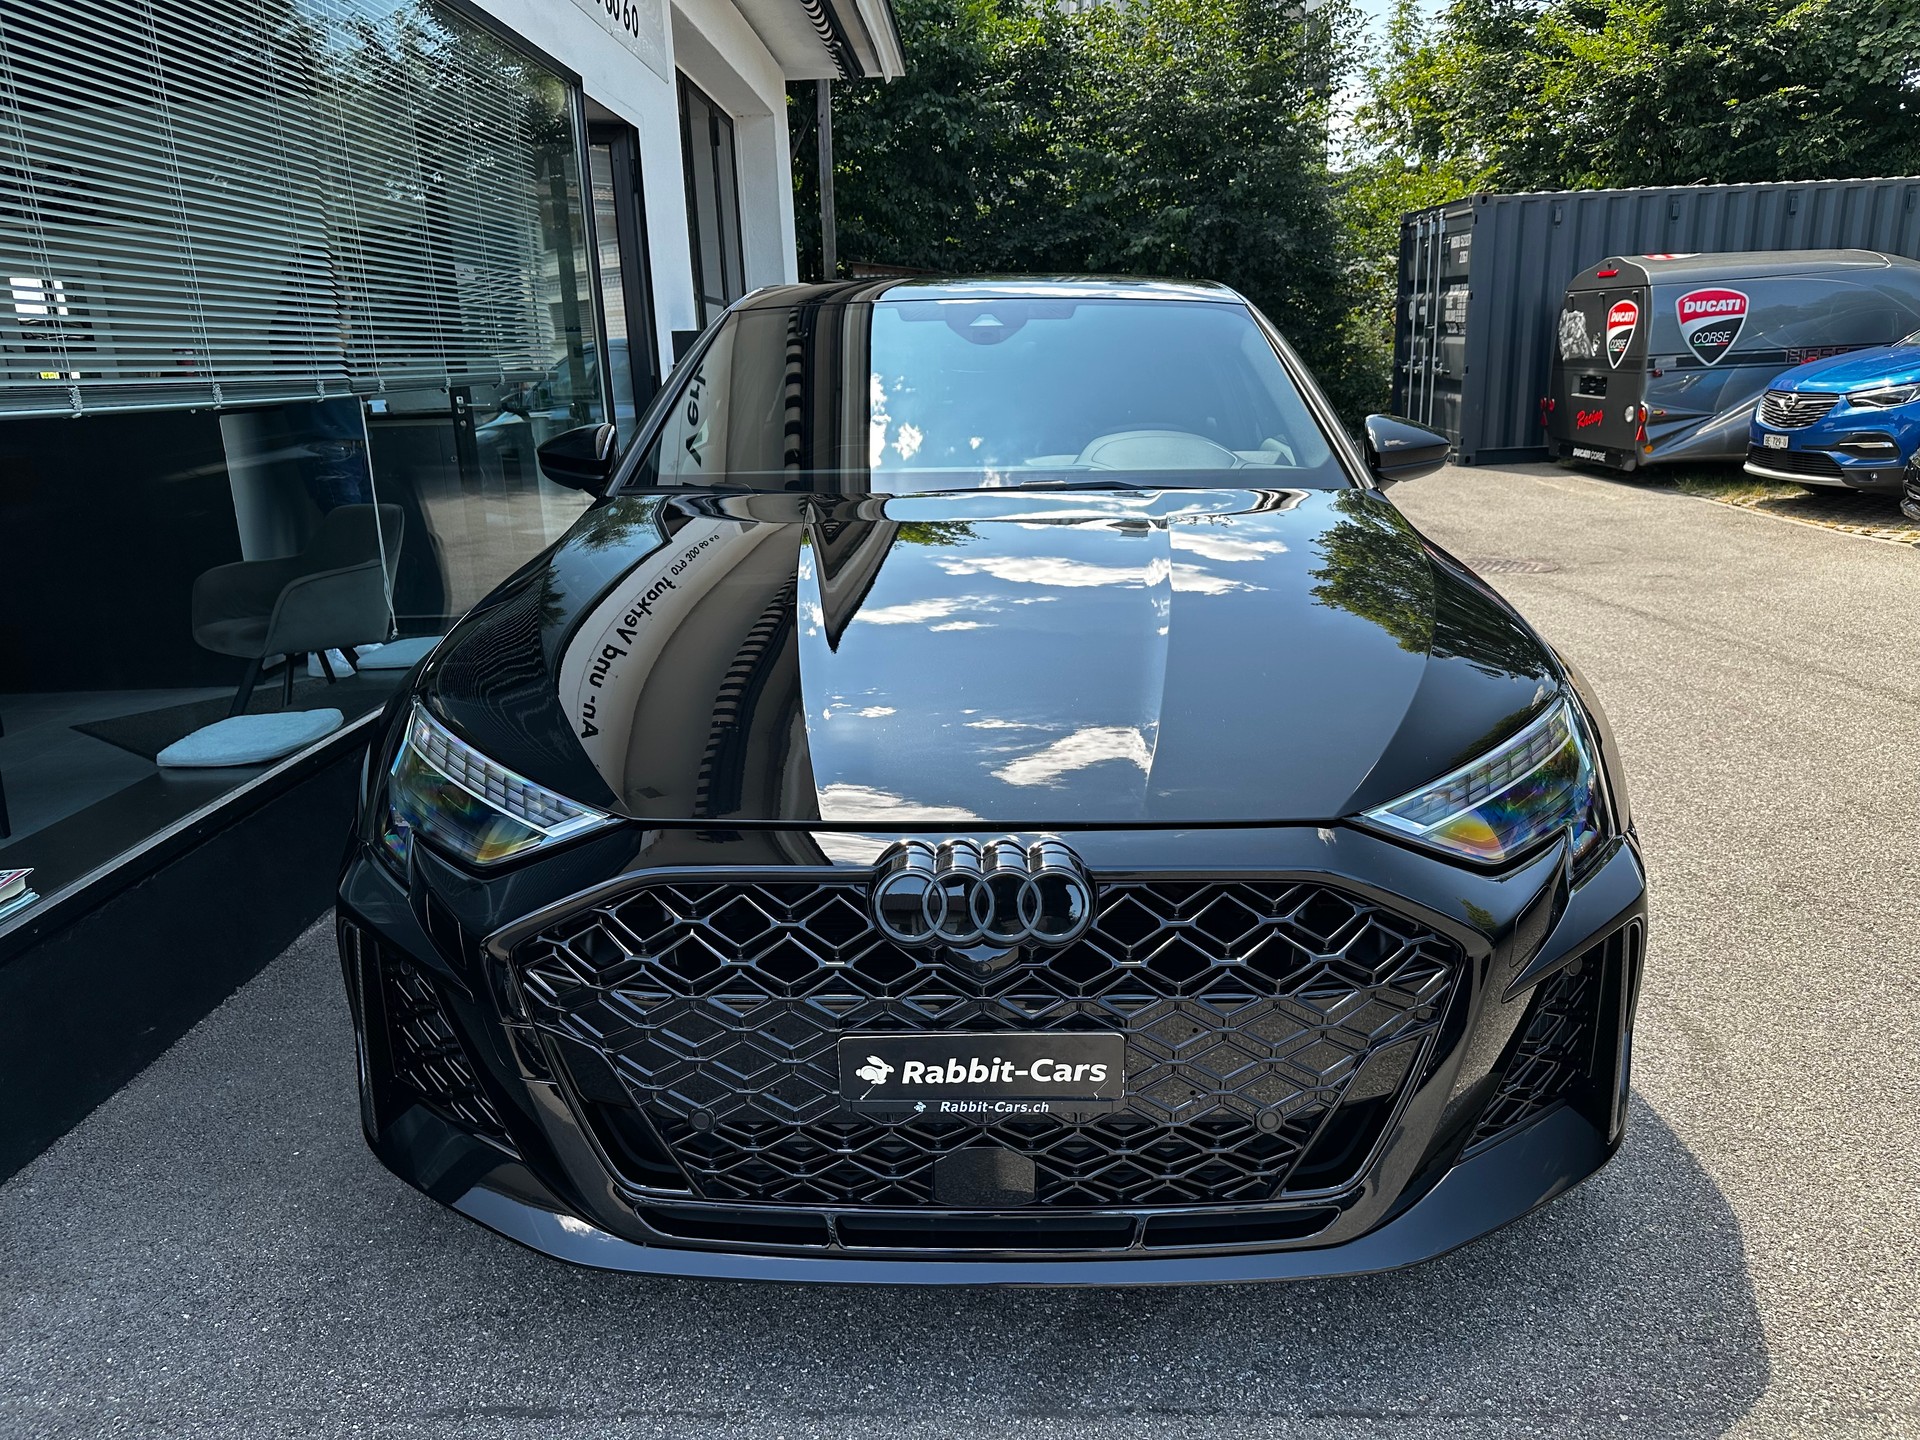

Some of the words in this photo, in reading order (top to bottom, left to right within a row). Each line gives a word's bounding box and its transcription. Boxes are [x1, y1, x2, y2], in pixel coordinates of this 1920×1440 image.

[623, 0, 639, 38] 60
[1683, 299, 1741, 314] DUCATI
[1610, 312, 1635, 323] DUCATI
[1610, 339, 1627, 349] CORSE
[1694, 331, 1732, 344] CORSE
[1576, 409, 1603, 430] Racing
[1572, 447, 1591, 459] DUCATI
[902, 1057, 1108, 1084] Rabbit-Cars
[940, 1101, 1050, 1113] Rabbit-Cars.ch
